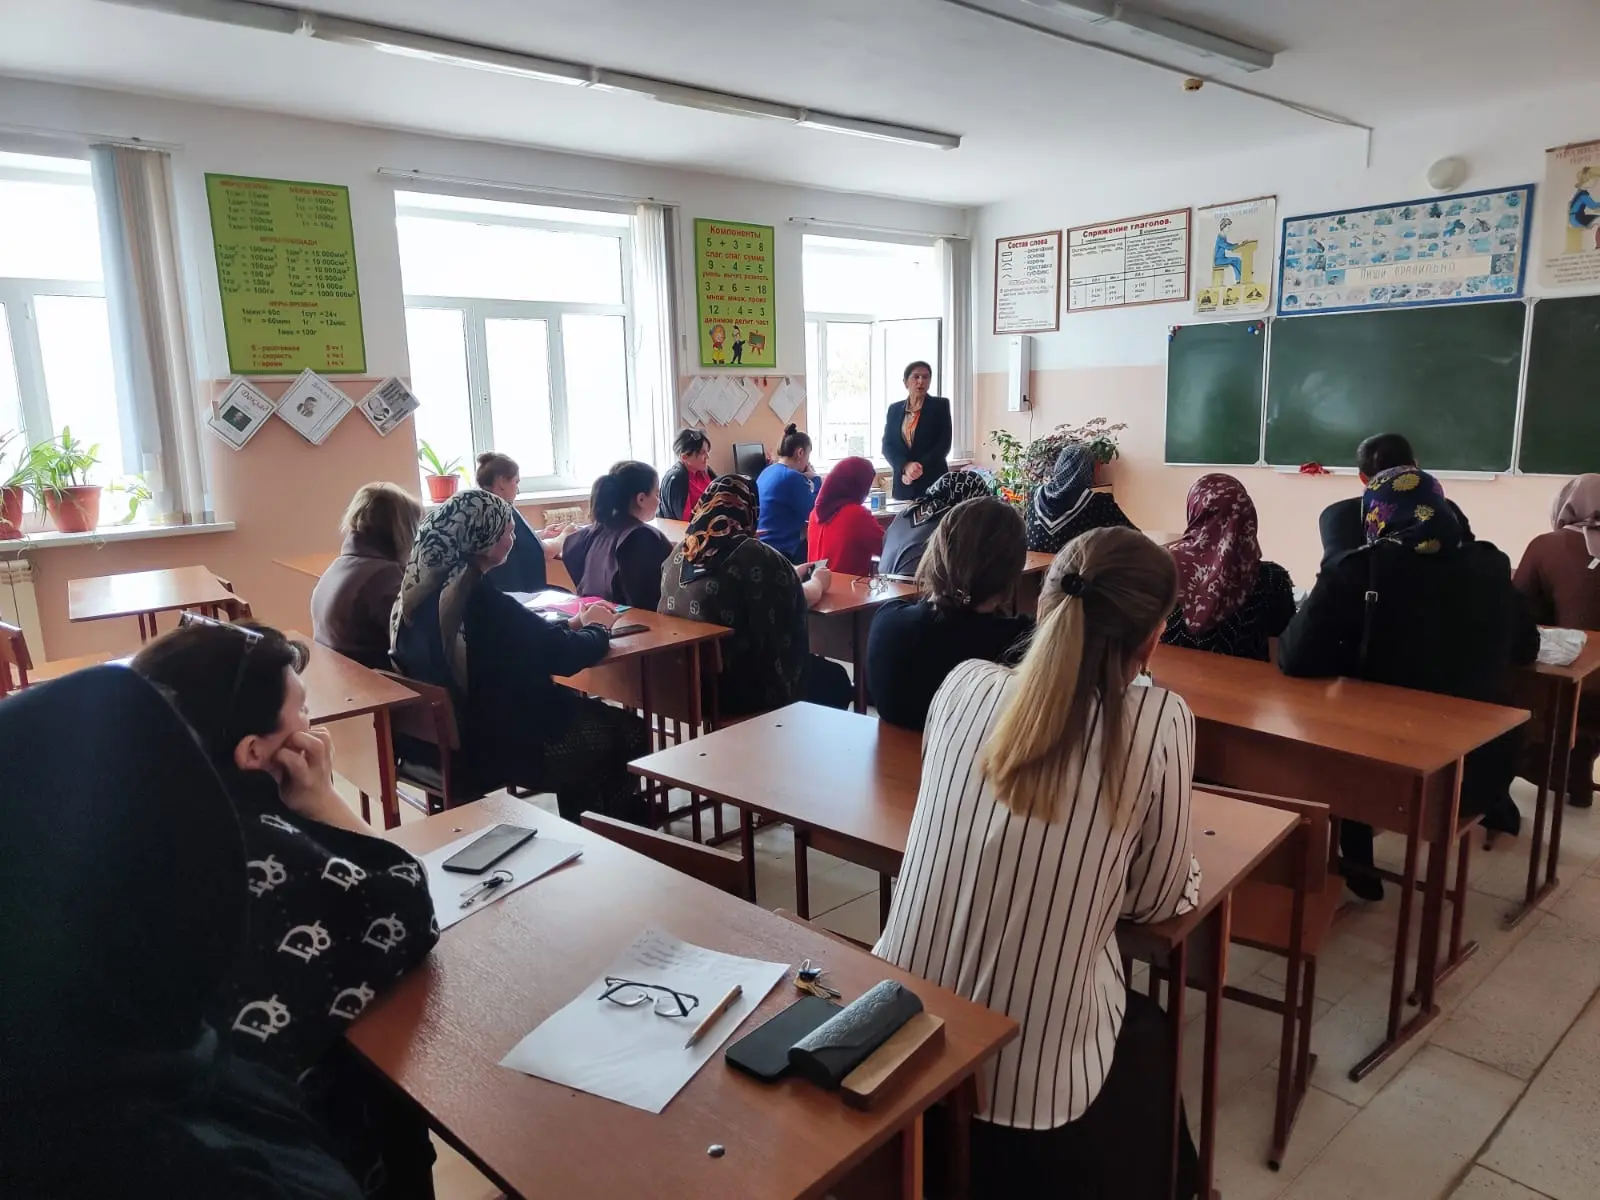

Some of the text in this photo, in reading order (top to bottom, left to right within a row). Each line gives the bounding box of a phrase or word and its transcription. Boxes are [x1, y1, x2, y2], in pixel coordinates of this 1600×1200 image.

[710, 224, 761, 239] Компоненты
[1083, 218, 1172, 238] Спряжение глаголов.
[707, 237, 712, 247] 5
[732, 239, 738, 250] 3
[758, 242, 764, 252] 8
[1030, 239, 1047, 247] слова
[708, 260, 714, 270] 9
[732, 261, 738, 271] 4
[758, 264, 764, 274] 5
[706, 281, 711, 291] 3
[732, 283, 738, 292] 6
[758, 285, 767, 295] 18
[709, 304, 719, 315] 12
[737, 305, 744, 315] 4
[760, 307, 765, 317] 3
